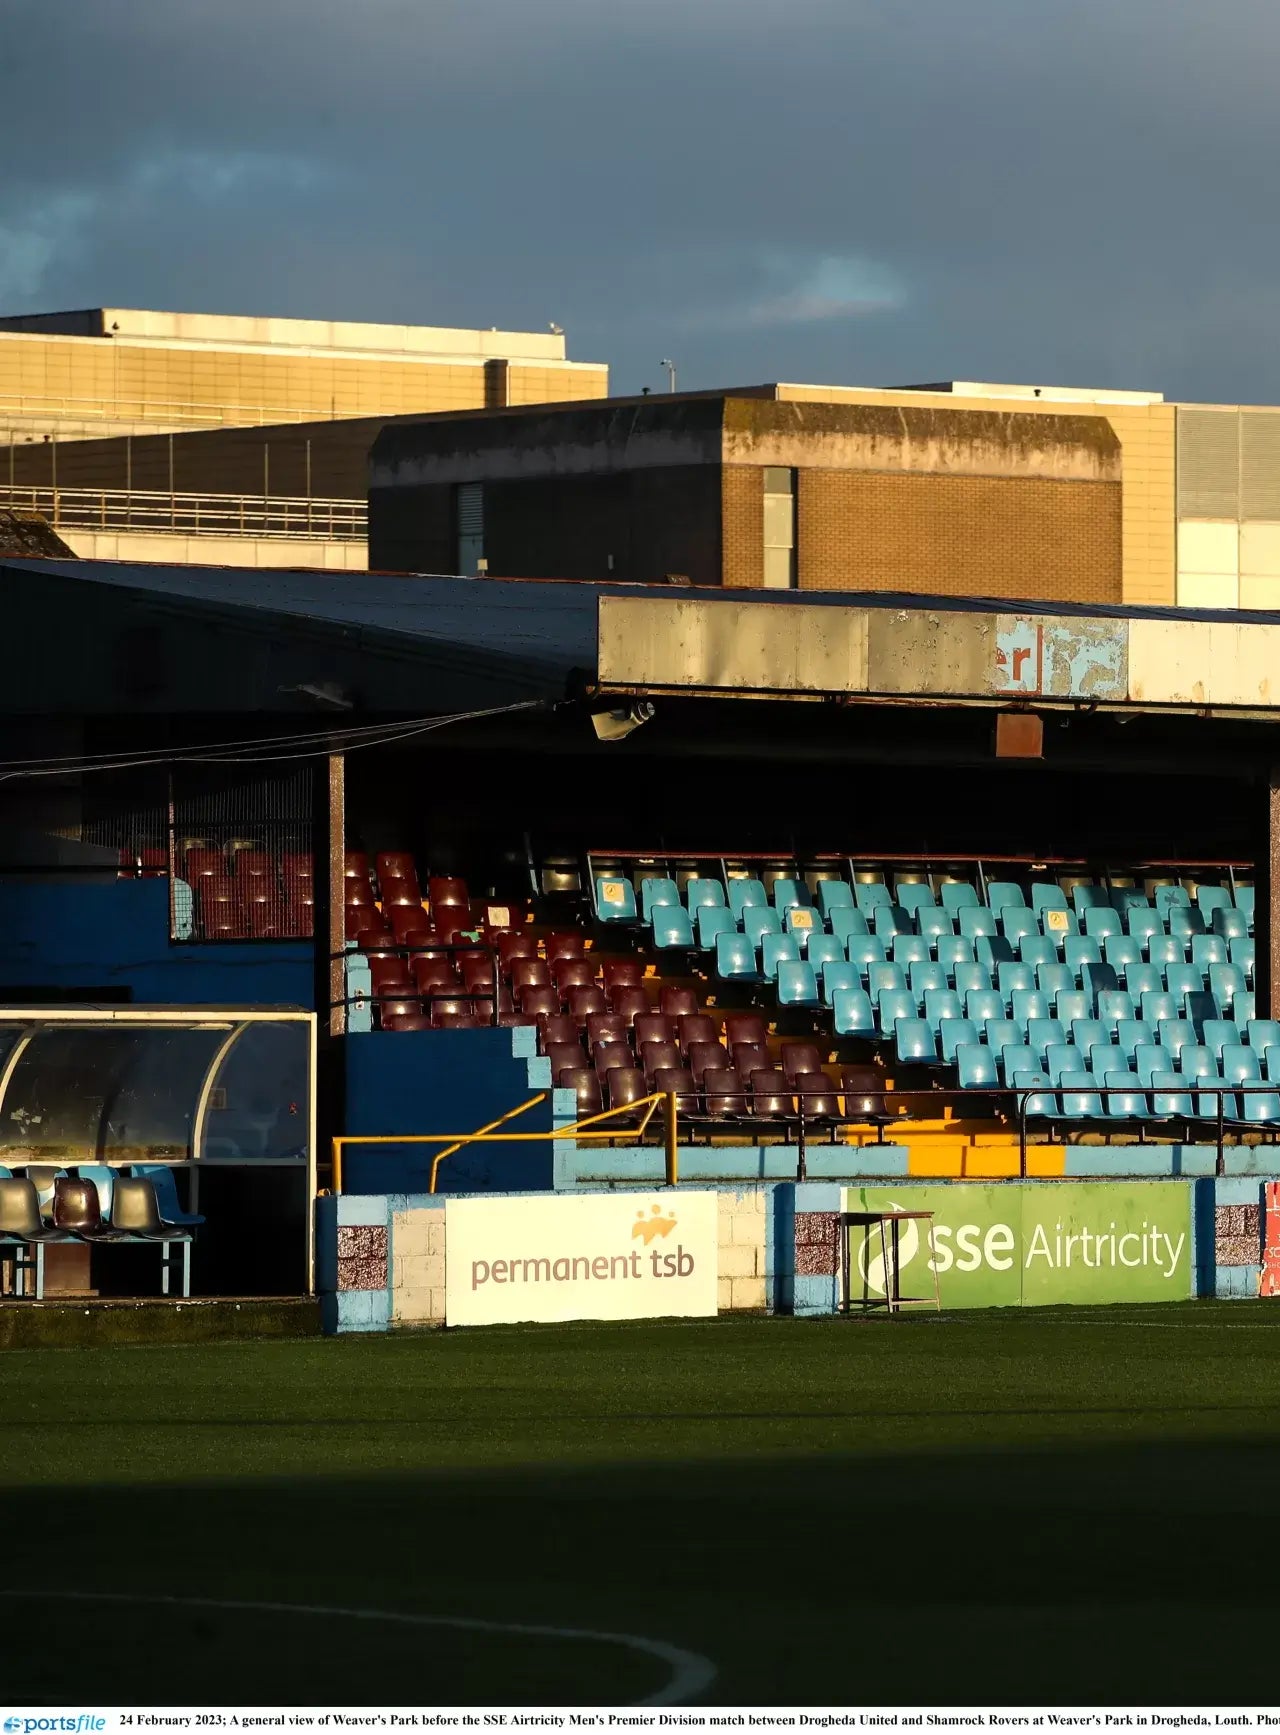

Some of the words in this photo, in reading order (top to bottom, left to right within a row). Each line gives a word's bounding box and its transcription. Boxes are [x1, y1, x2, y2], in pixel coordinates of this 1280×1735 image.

[471, 1250, 642, 1291] permanent
[652, 1244, 695, 1278] tsb
[927, 1223, 1015, 1272] sse
[1025, 1221, 1185, 1278] Airtricity
